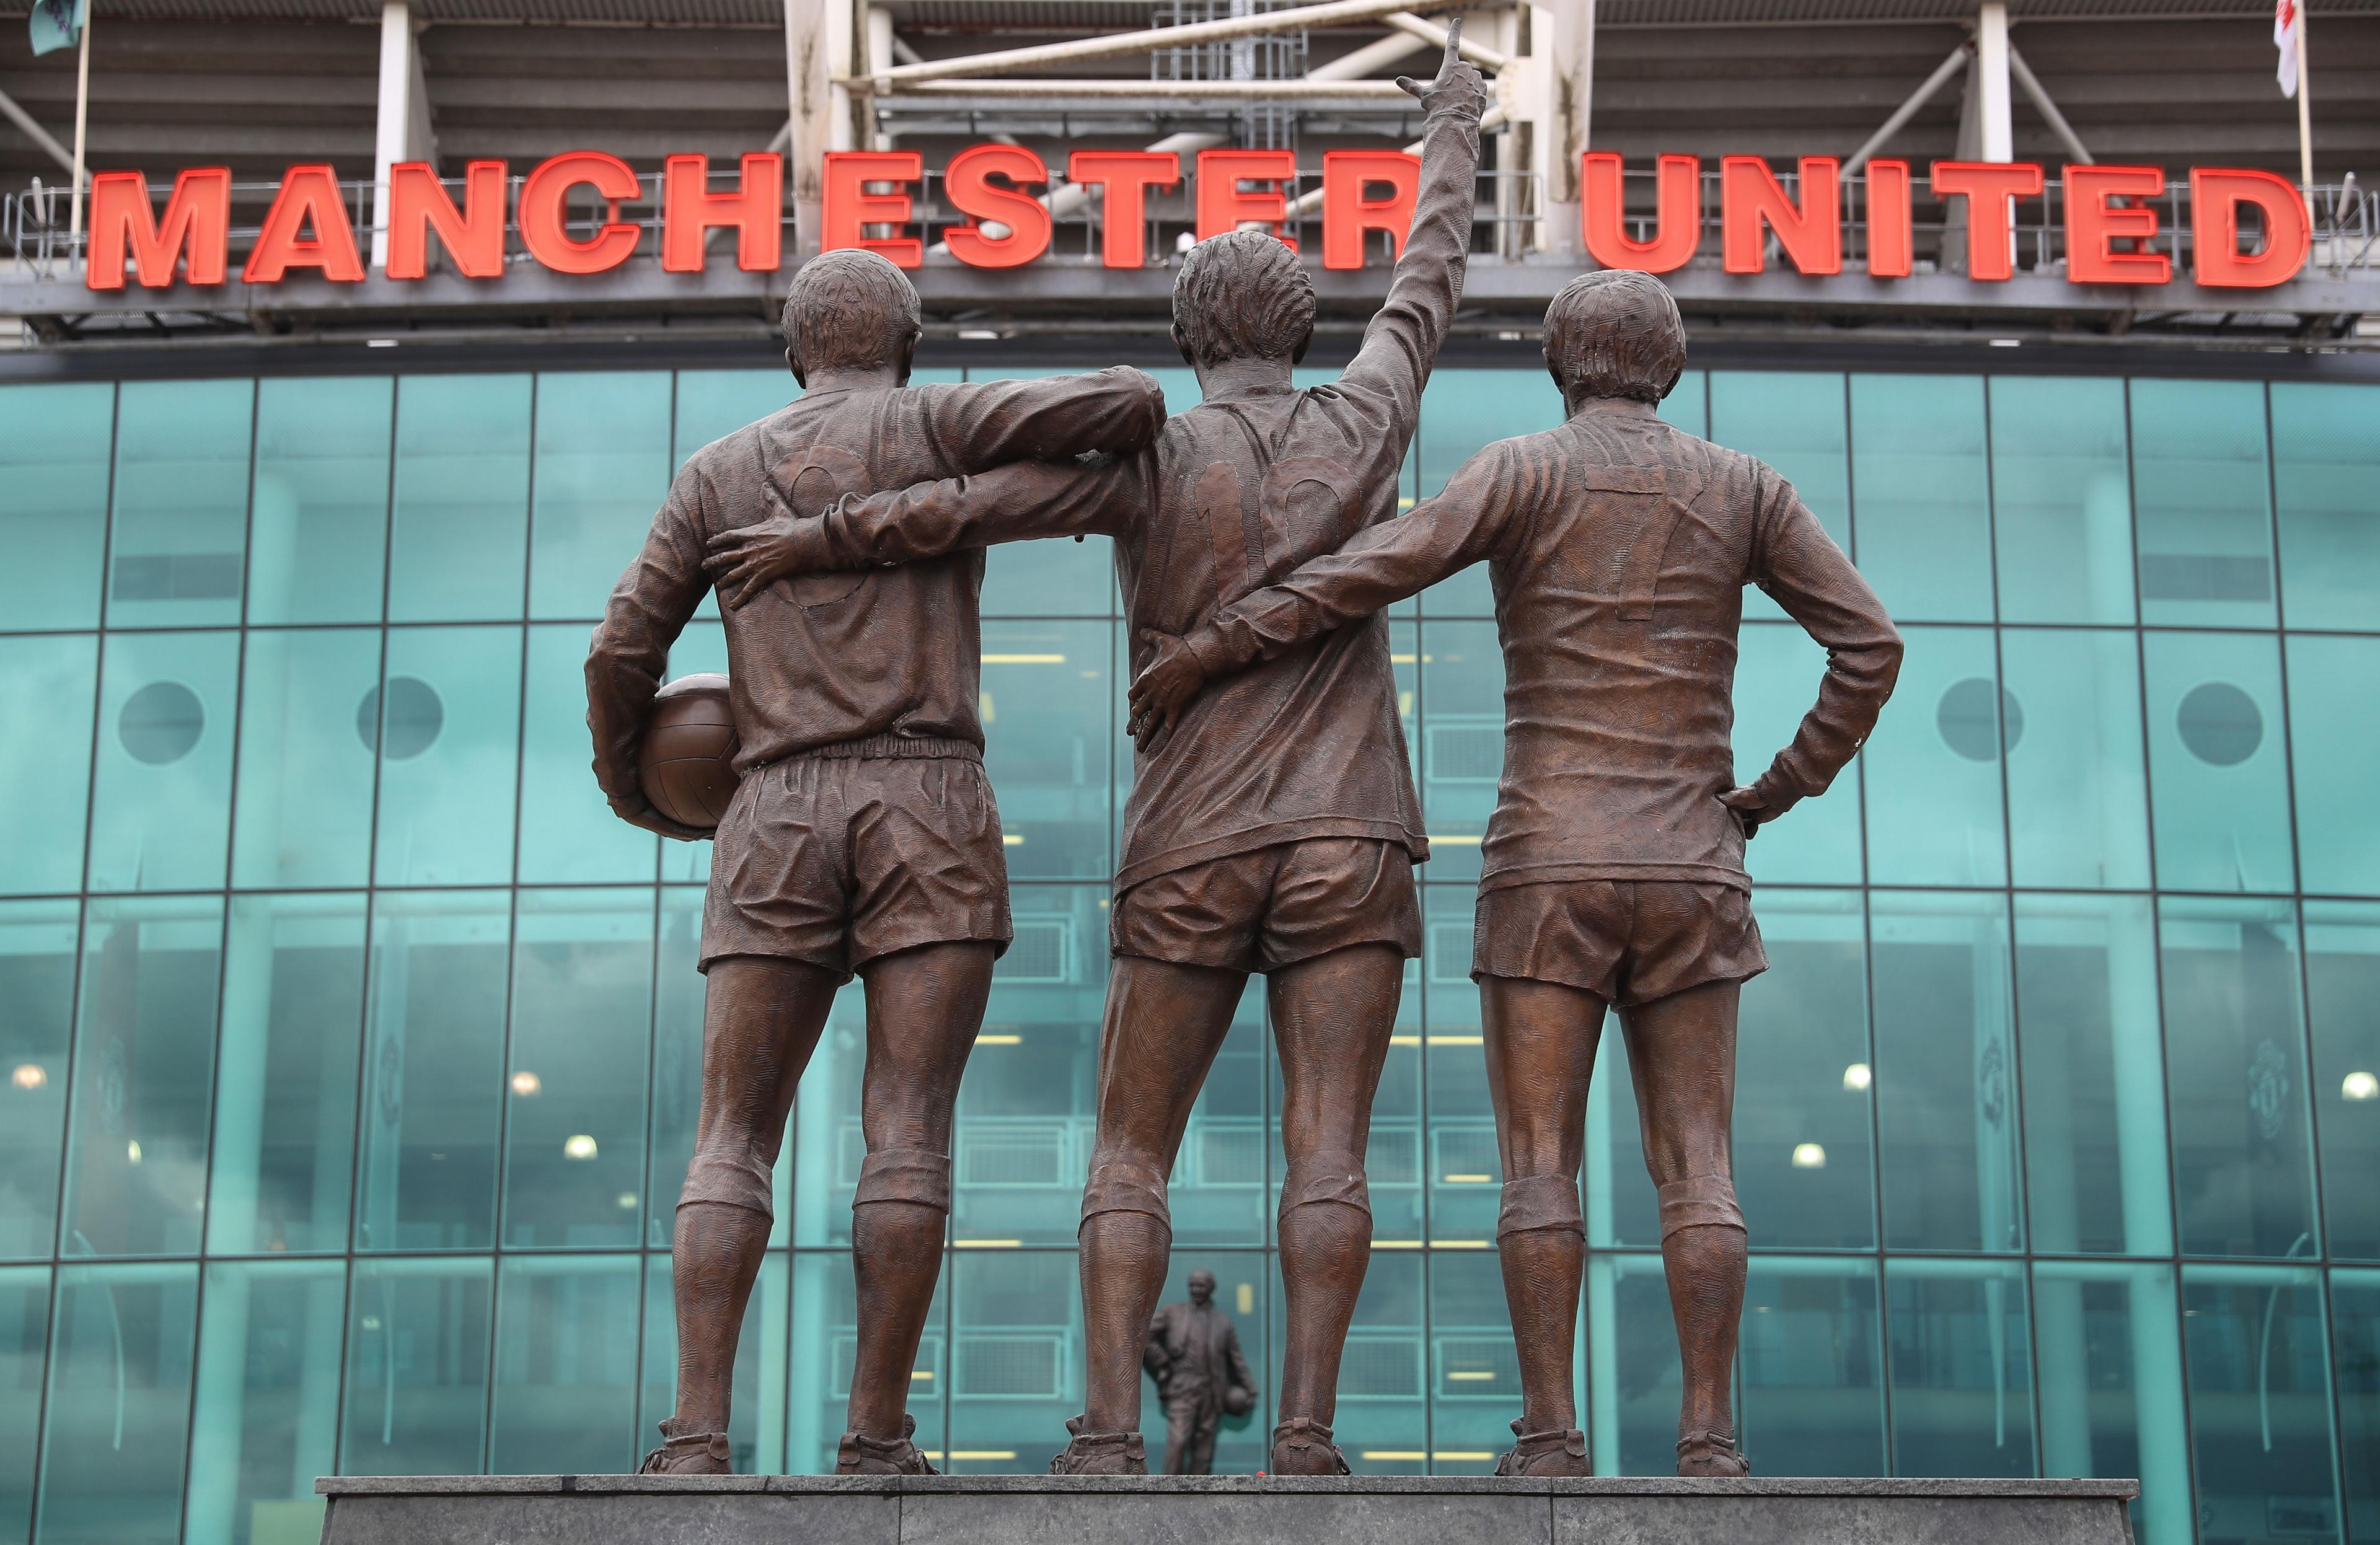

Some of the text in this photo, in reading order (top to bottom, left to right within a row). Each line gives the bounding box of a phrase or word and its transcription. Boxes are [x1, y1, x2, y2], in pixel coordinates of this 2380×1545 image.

[85, 143, 2312, 290] MANCHESTER UNITED
[1196, 456, 1362, 609] 10
[1584, 464, 1703, 620] 7
